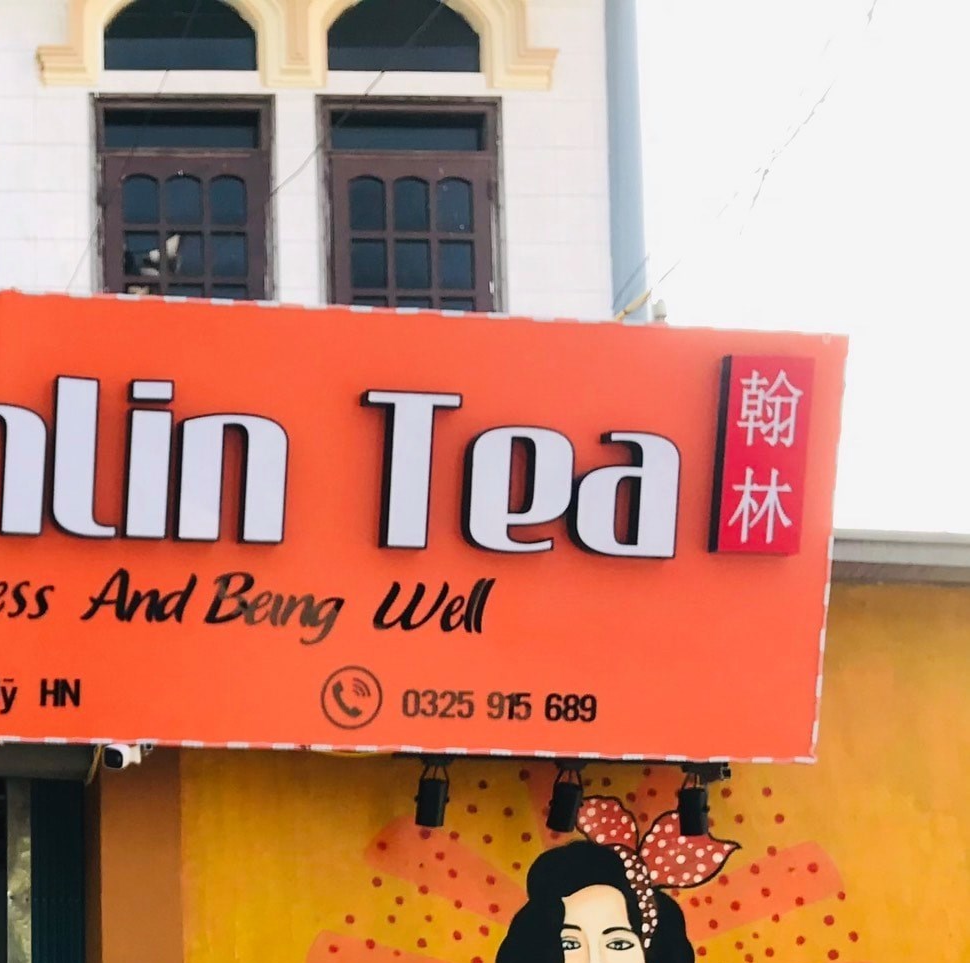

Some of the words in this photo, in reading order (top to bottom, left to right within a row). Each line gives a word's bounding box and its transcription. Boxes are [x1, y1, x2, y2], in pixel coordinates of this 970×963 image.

[361, 388, 681, 559] Tea
[728, 369, 804, 544] 翰林
[79, 567, 197, 623] And
[372, 578, 496, 634] Well
[40, 678, 81, 707] HN
[401, 689, 475, 719] 0325
[486, 691, 532, 720] 915
[544, 692, 597, 722] 689
